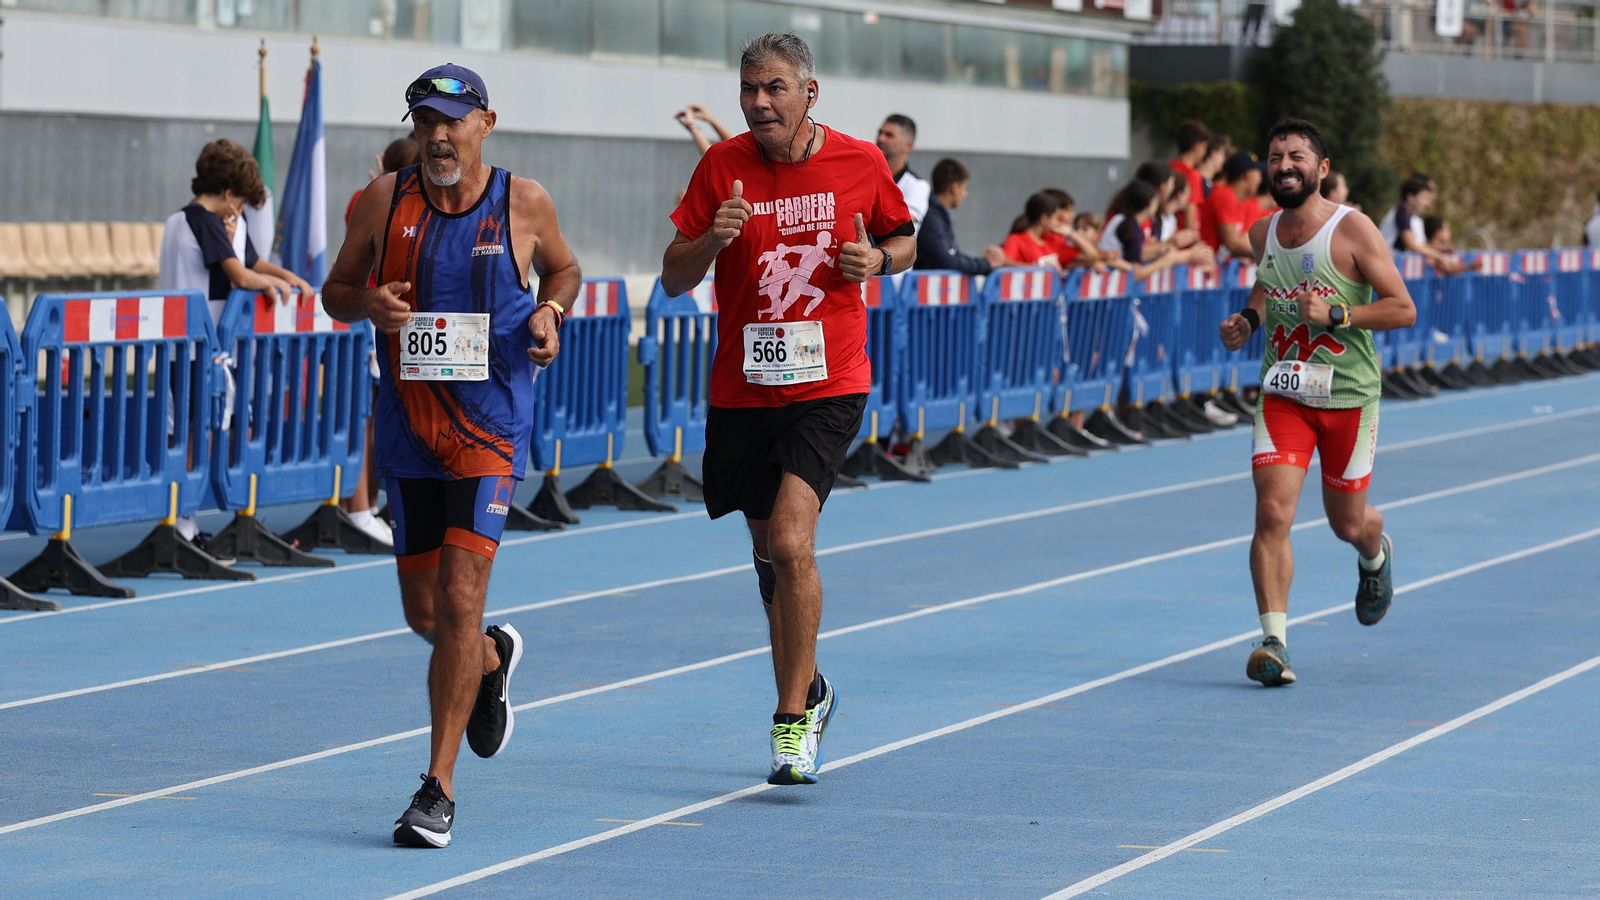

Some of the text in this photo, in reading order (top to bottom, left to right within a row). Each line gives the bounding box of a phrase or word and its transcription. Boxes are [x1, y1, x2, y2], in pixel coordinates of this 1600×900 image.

[753, 192, 836, 216] XLII CARRERA
[776, 205, 835, 227] POPULAR
[806, 223, 815, 231] DE
[1271, 302, 1298, 313] JER
[407, 331, 448, 356] 805
[752, 340, 788, 363] 566
[1269, 372, 1300, 391] 490
